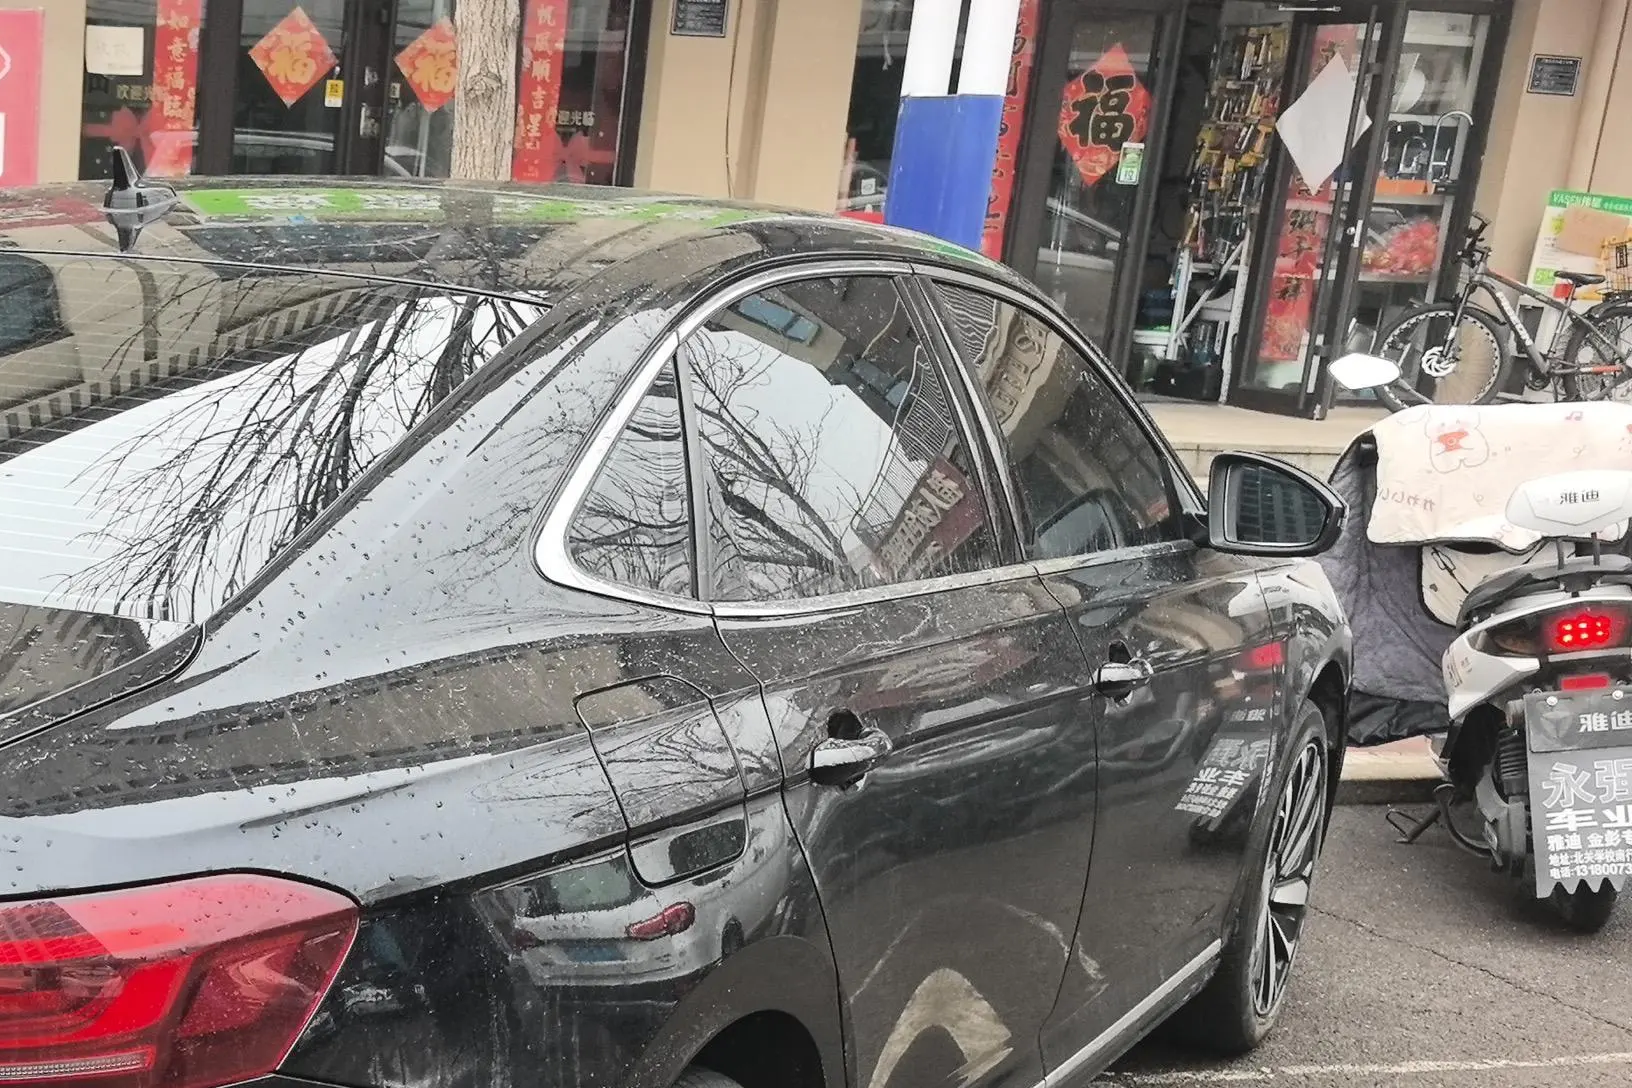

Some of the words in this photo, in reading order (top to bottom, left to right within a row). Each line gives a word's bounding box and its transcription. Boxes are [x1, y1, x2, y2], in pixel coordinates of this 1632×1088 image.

[268, 31, 317, 85] 福
[1068, 69, 1136, 153] 福
[1559, 488, 1600, 505] 雅迪
[1578, 710, 1632, 733] 雅迪
[1542, 758, 1632, 809] 永强
